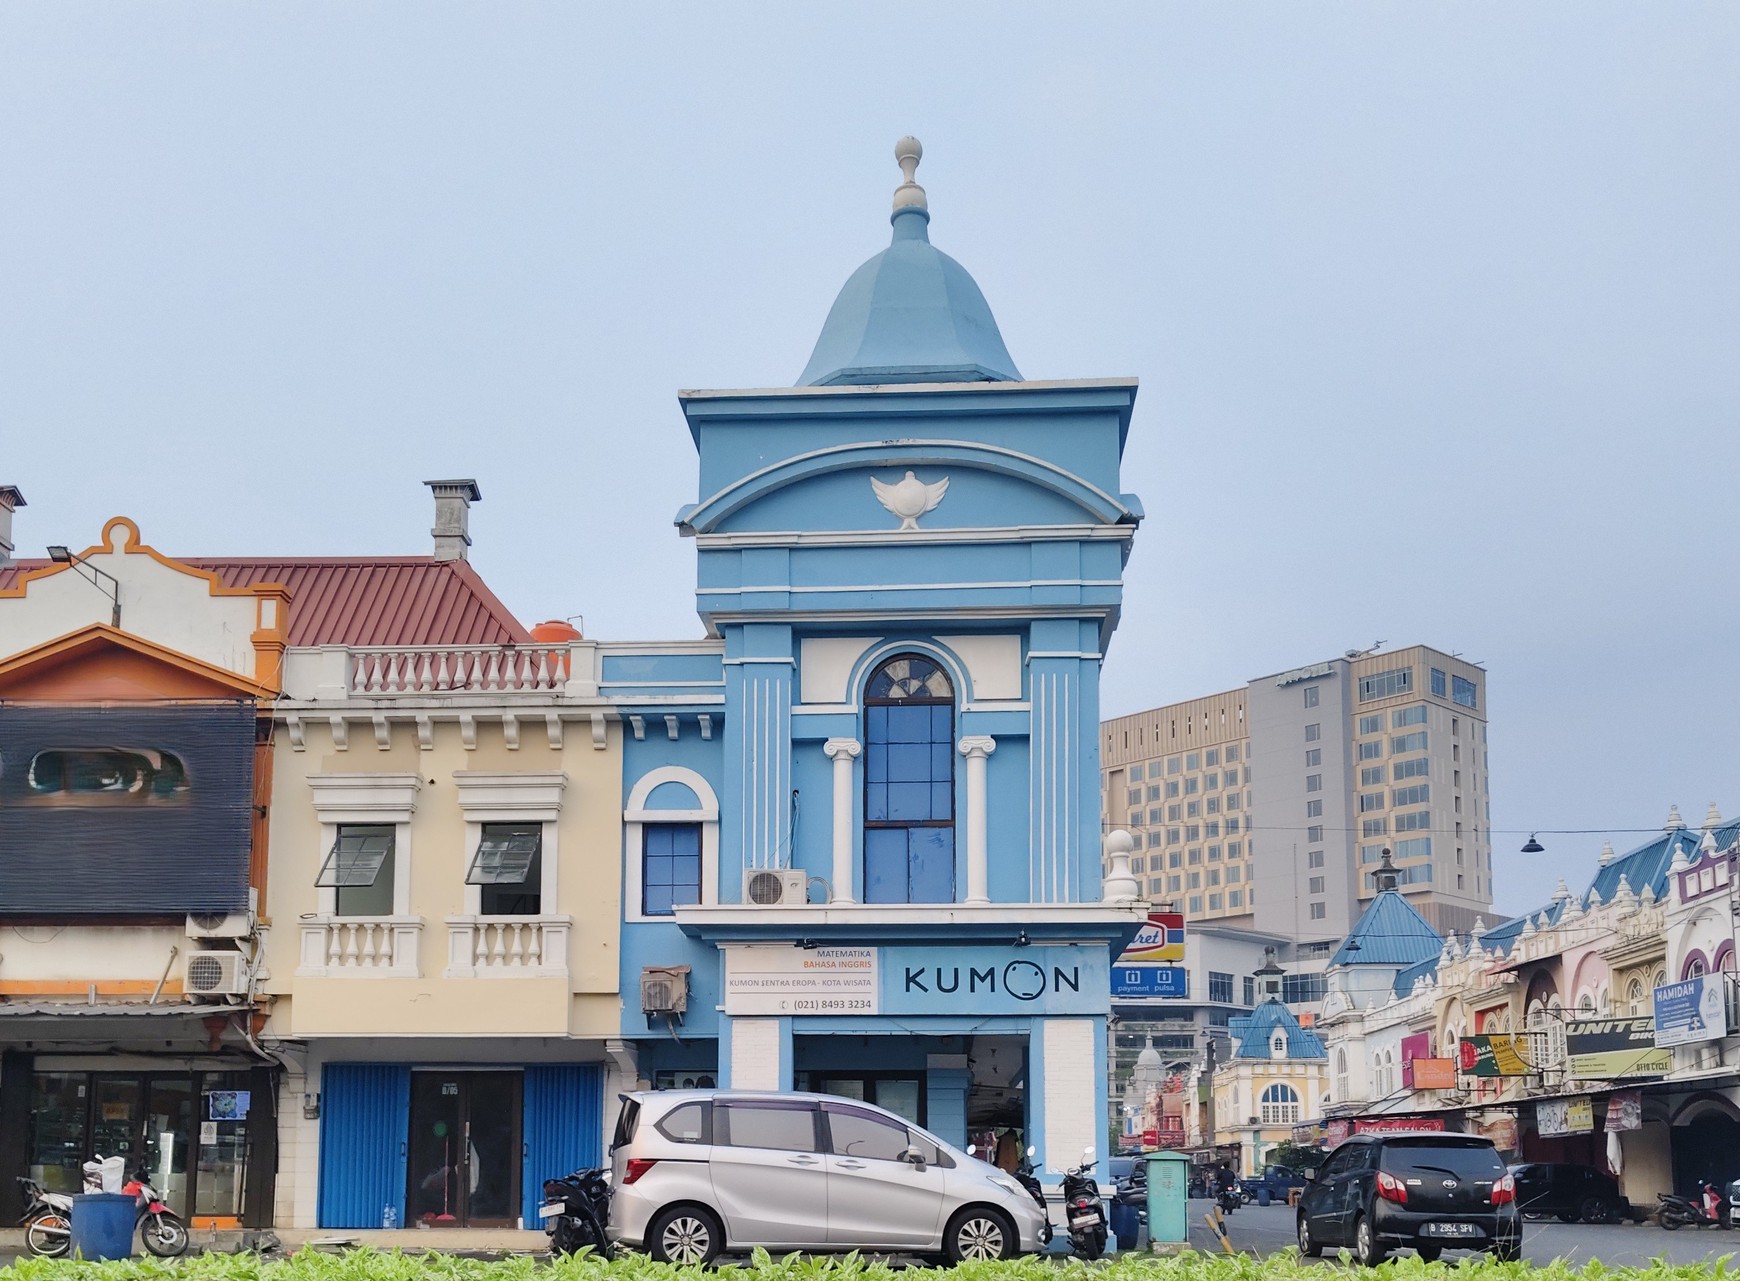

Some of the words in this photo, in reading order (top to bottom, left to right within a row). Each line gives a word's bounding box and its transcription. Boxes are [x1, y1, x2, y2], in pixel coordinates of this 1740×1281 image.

[817, 950, 871, 958] MATEMATIKA
[729, 979, 759, 987] KUMON
[761, 979, 790, 987] SENTRA
[792, 979, 816, 987] EROPA
[822, 979, 842, 987] KOTA
[843, 979, 872, 987] WISATA
[905, 960, 1079, 1001] KUMON
[1154, 984, 1174, 992] pulsa
[1656, 983, 1695, 1002] HAMIDAH
[794, 1000, 819, 1010] (021)
[821, 1000, 845, 1009] 8493
[847, 1000, 871, 1009] 3234
[1566, 1019, 1654, 1036] UNITE
[1628, 1032, 1654, 1040] BIK
[1430, 1223, 1435, 1231] B
